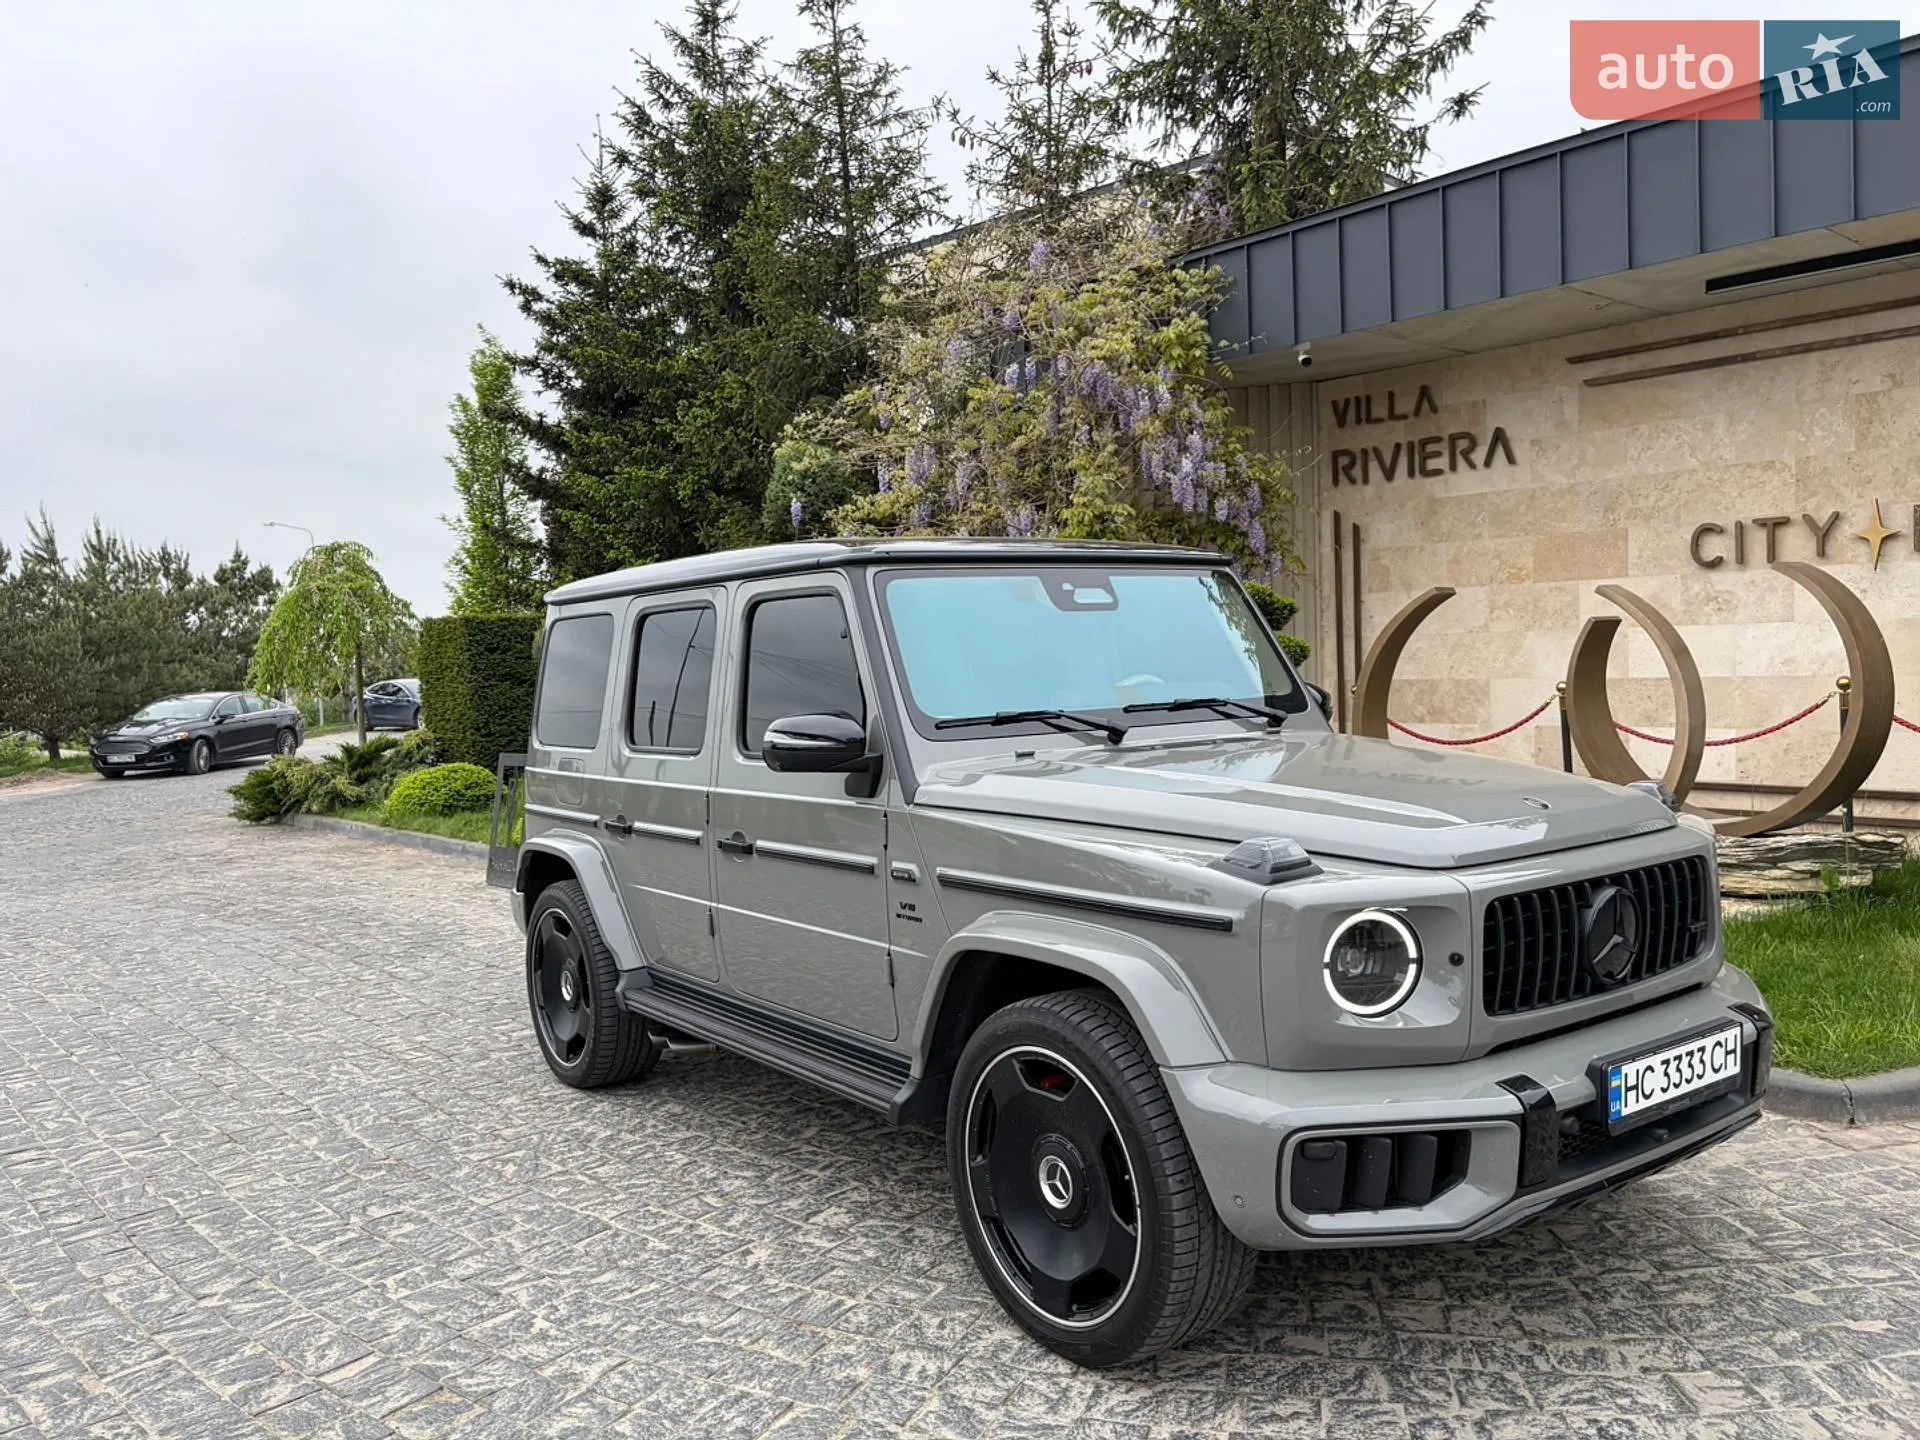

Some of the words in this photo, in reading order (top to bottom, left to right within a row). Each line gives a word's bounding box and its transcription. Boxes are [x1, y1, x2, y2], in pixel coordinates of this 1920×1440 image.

[1331, 384, 1440, 428] VILLA
[1331, 426, 1517, 487] RIVIERA
[1690, 510, 1840, 569] CITY
[1624, 1065, 1655, 1108] HC
[1660, 1045, 1706, 1094] 3333
[1711, 1034, 1738, 1074] CH
